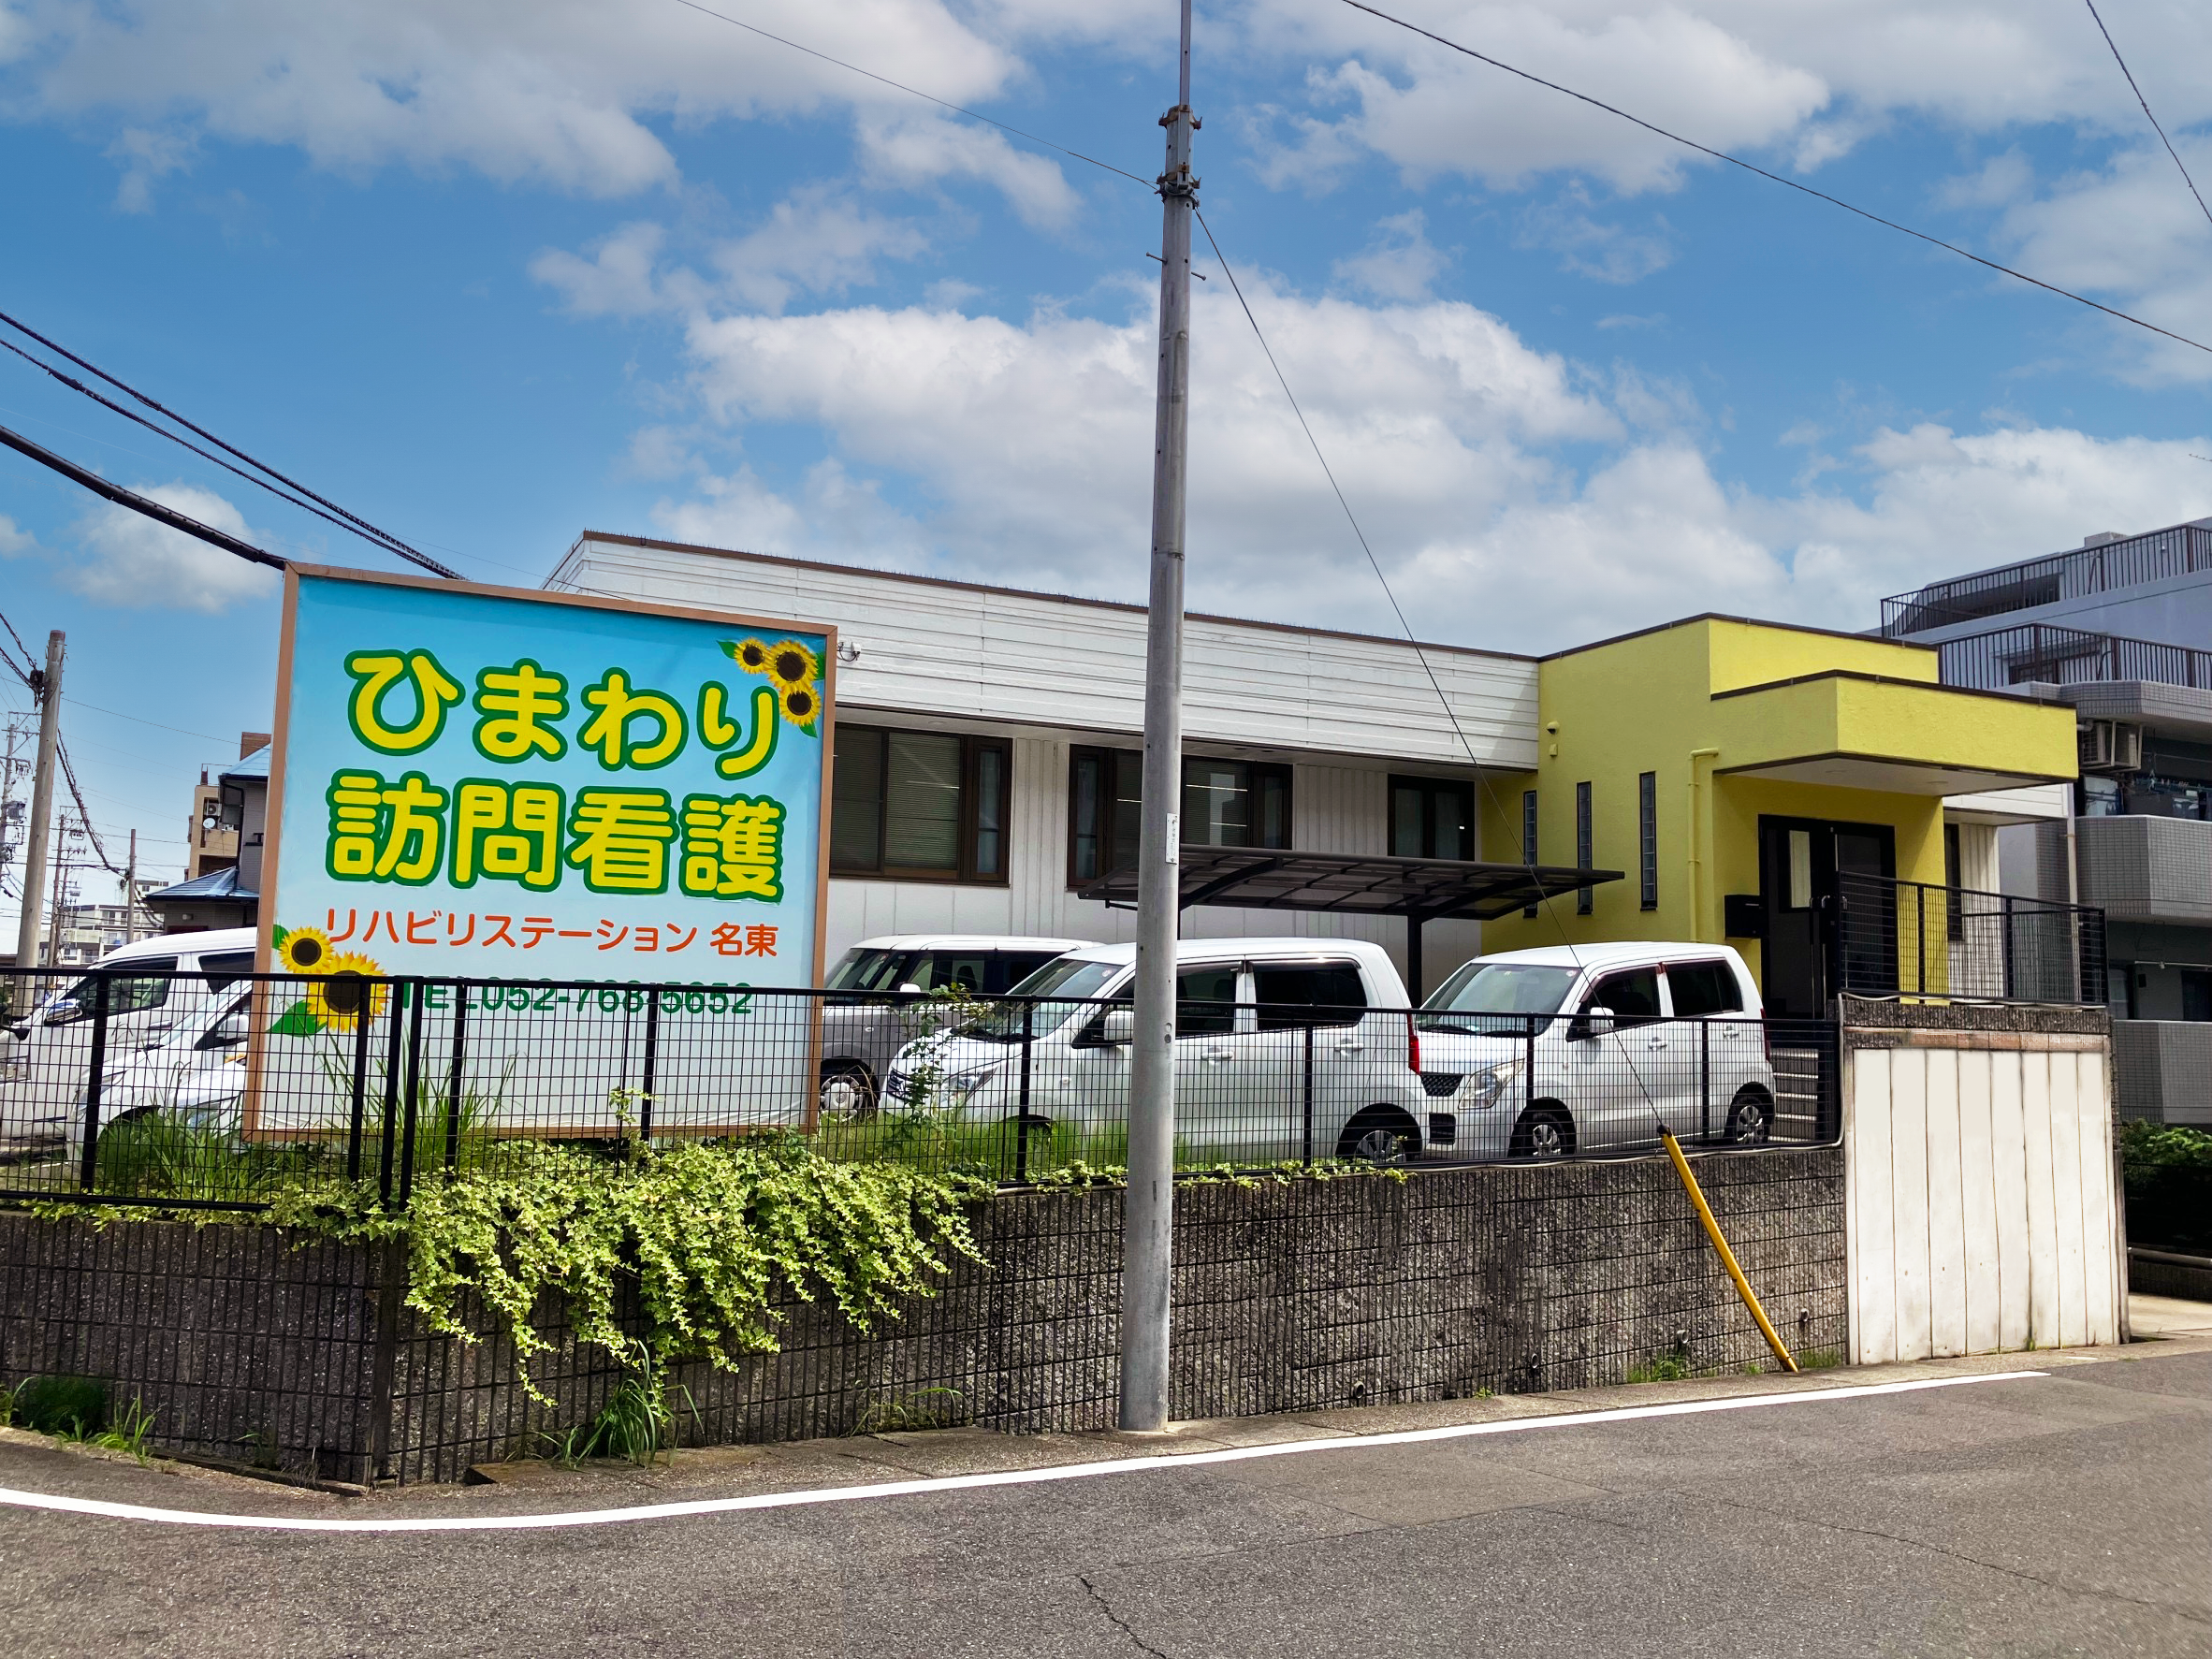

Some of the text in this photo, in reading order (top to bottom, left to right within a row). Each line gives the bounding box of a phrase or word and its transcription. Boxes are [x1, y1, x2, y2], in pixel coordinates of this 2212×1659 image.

[343, 648, 780, 781] ひまわり
[326, 767, 787, 903] 訪問看護
[327, 909, 779, 958] リハビリステーション 名東
